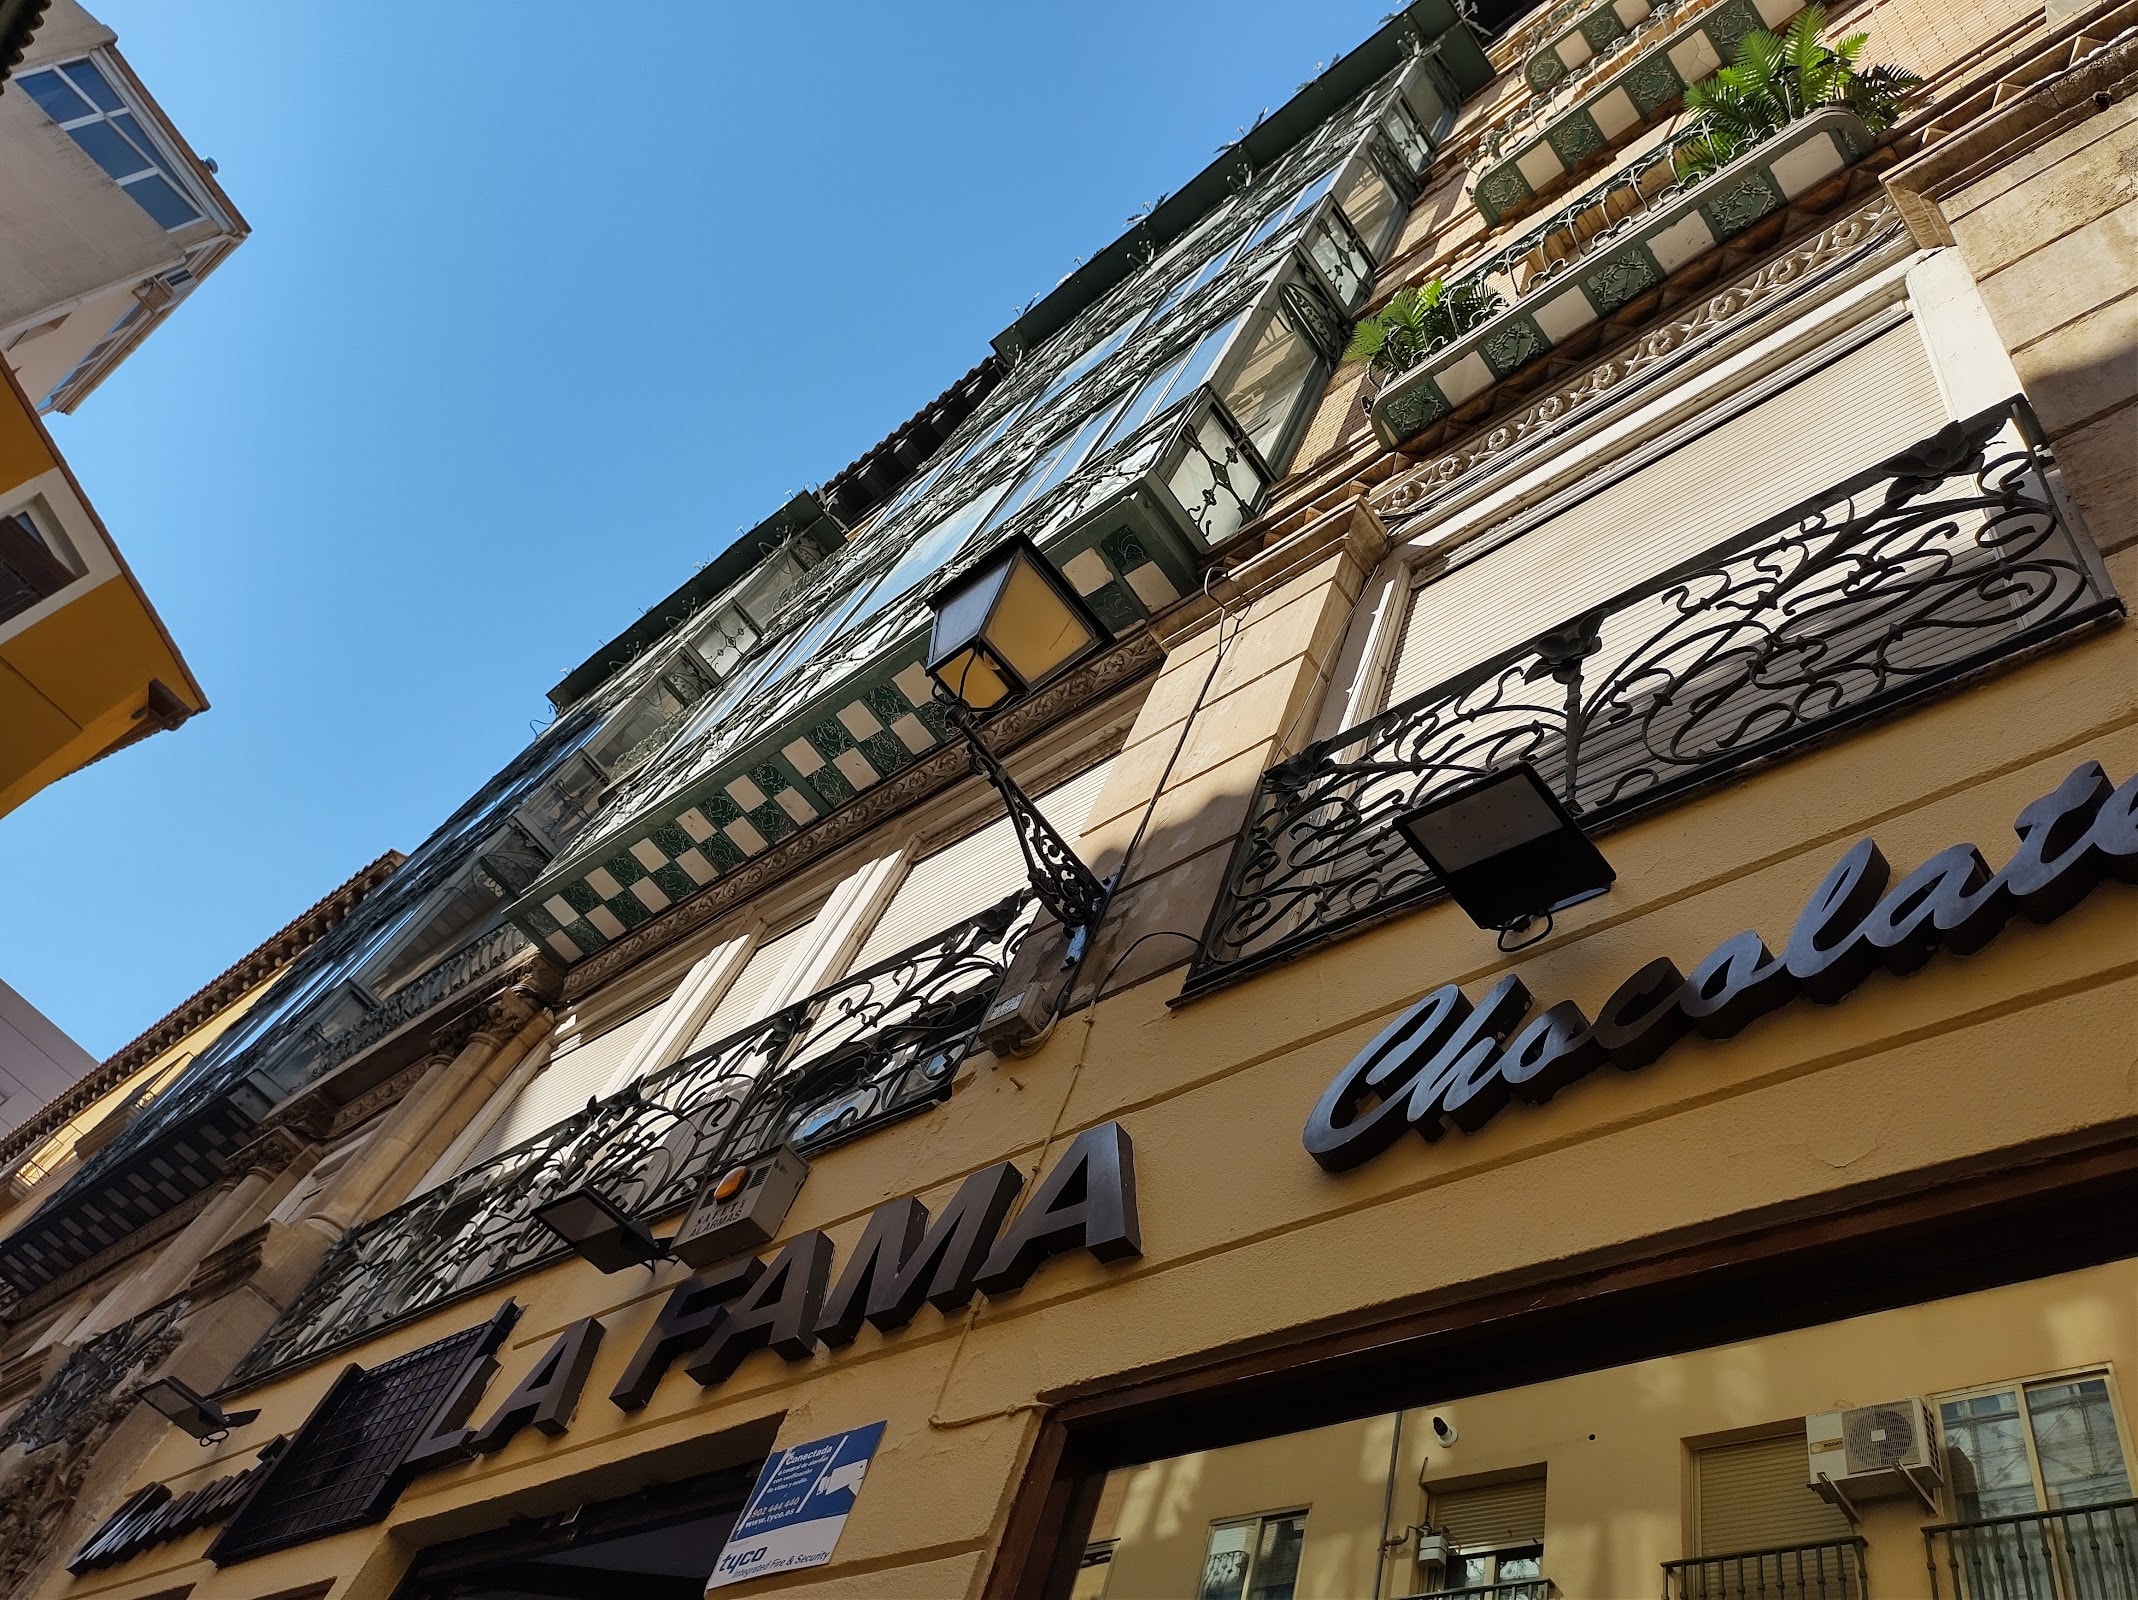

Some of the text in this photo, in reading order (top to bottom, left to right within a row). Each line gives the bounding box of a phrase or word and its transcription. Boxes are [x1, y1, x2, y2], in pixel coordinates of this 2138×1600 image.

[688, 1209, 742, 1239] ALARMAS
[398, 1121, 1140, 1469] LA FAMA
[785, 1444, 832, 1466] Conectada
[745, 1508, 796, 1529] www.tyco.es
[751, 1496, 800, 1518] 902 444 440
[719, 1546, 768, 1575] tyco
[731, 1550, 830, 1579] Integrated Fire & Security
